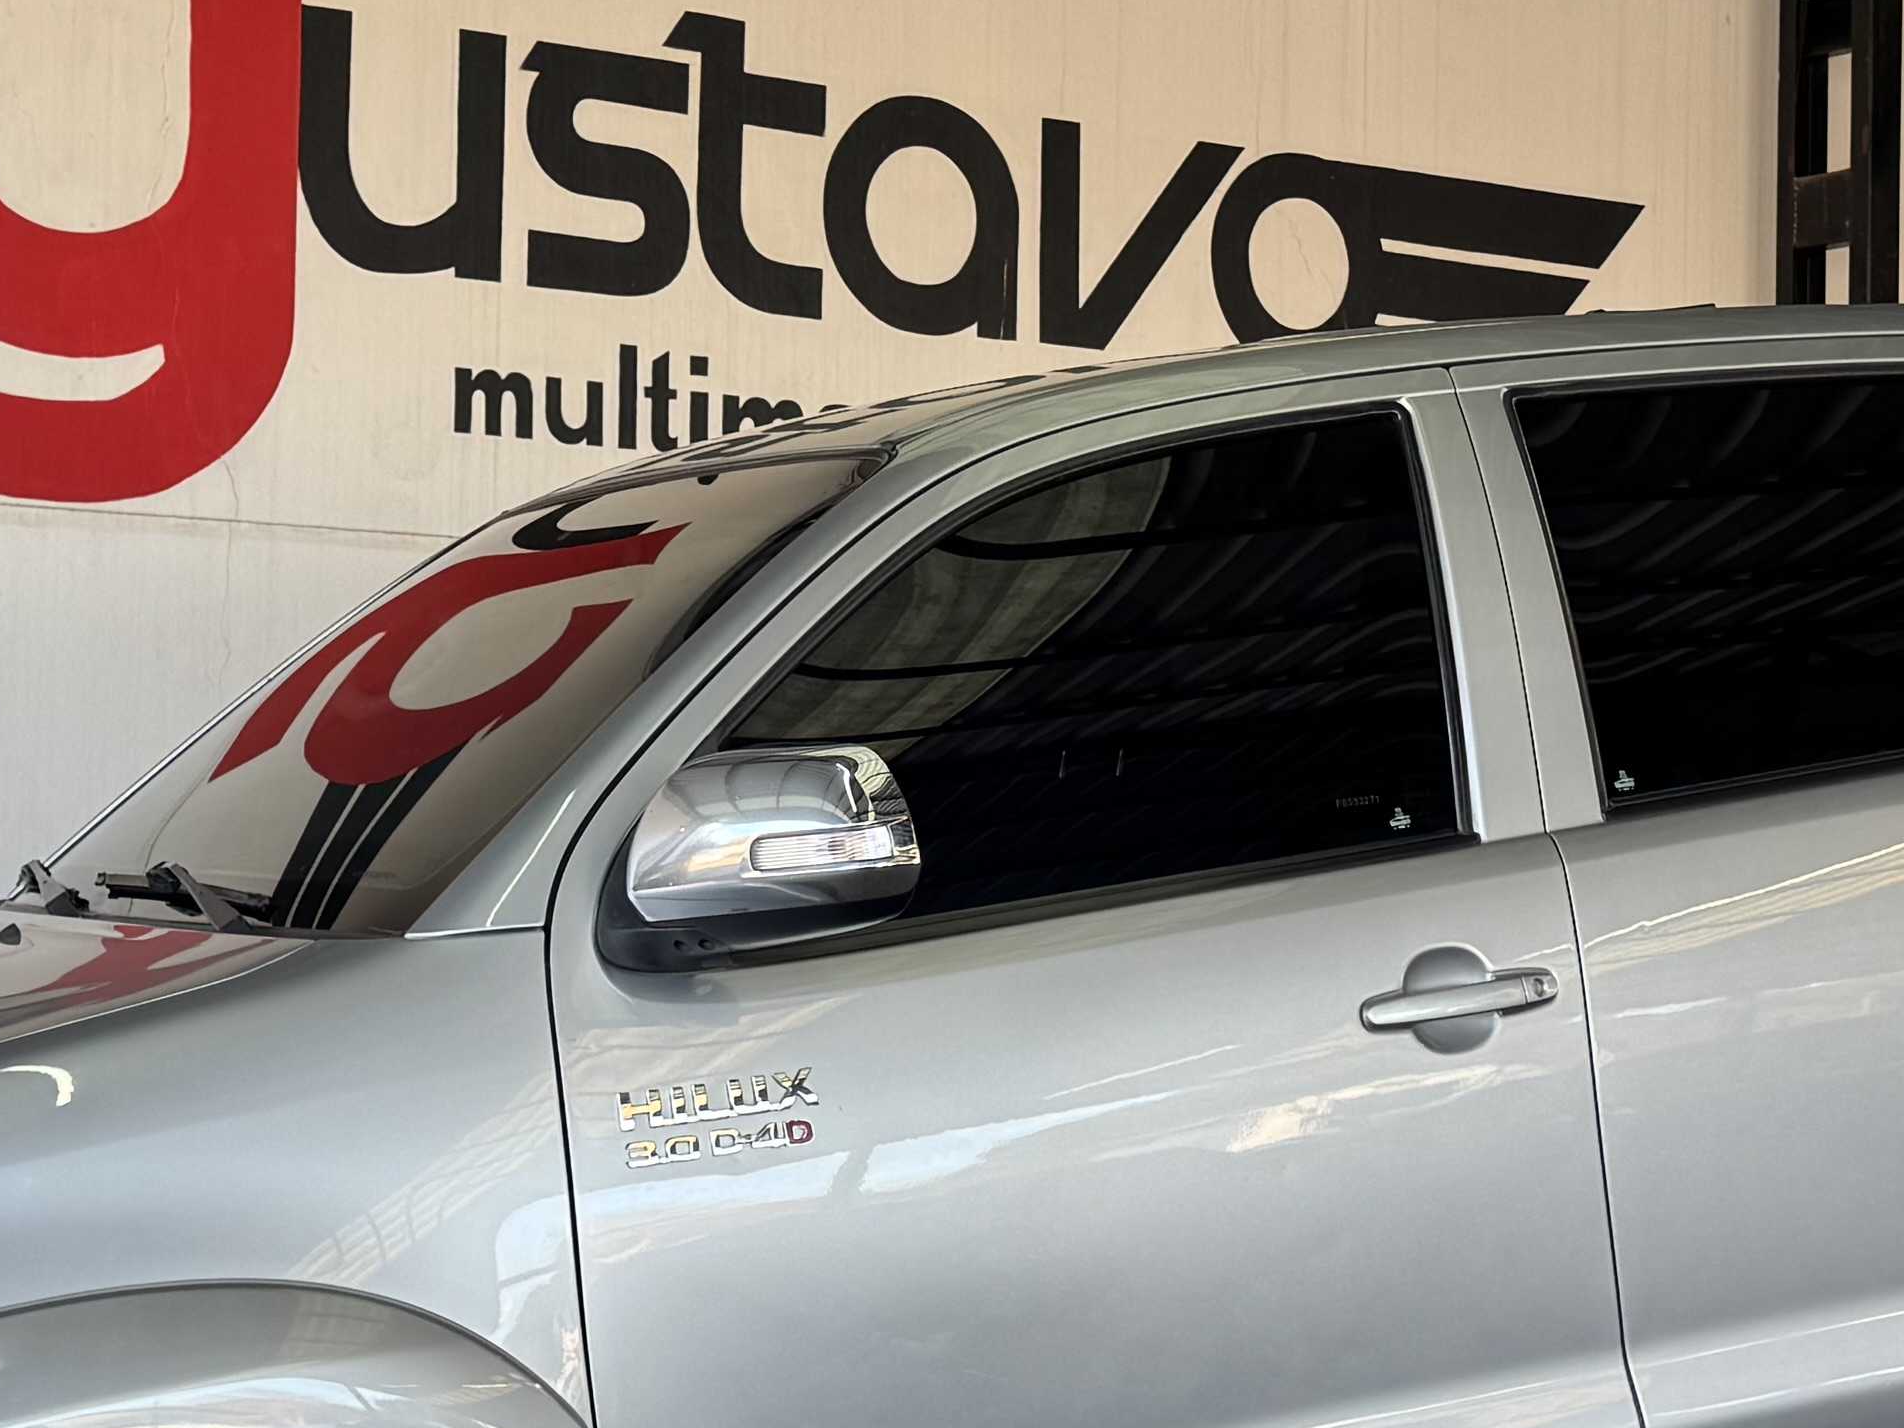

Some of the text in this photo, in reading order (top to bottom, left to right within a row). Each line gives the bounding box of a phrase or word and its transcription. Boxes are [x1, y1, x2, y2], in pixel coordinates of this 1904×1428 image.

[454, 344, 853, 452] multim
[616, 1067, 819, 1131] HILUX
[625, 1120, 816, 1169] 3.0 D-4D
